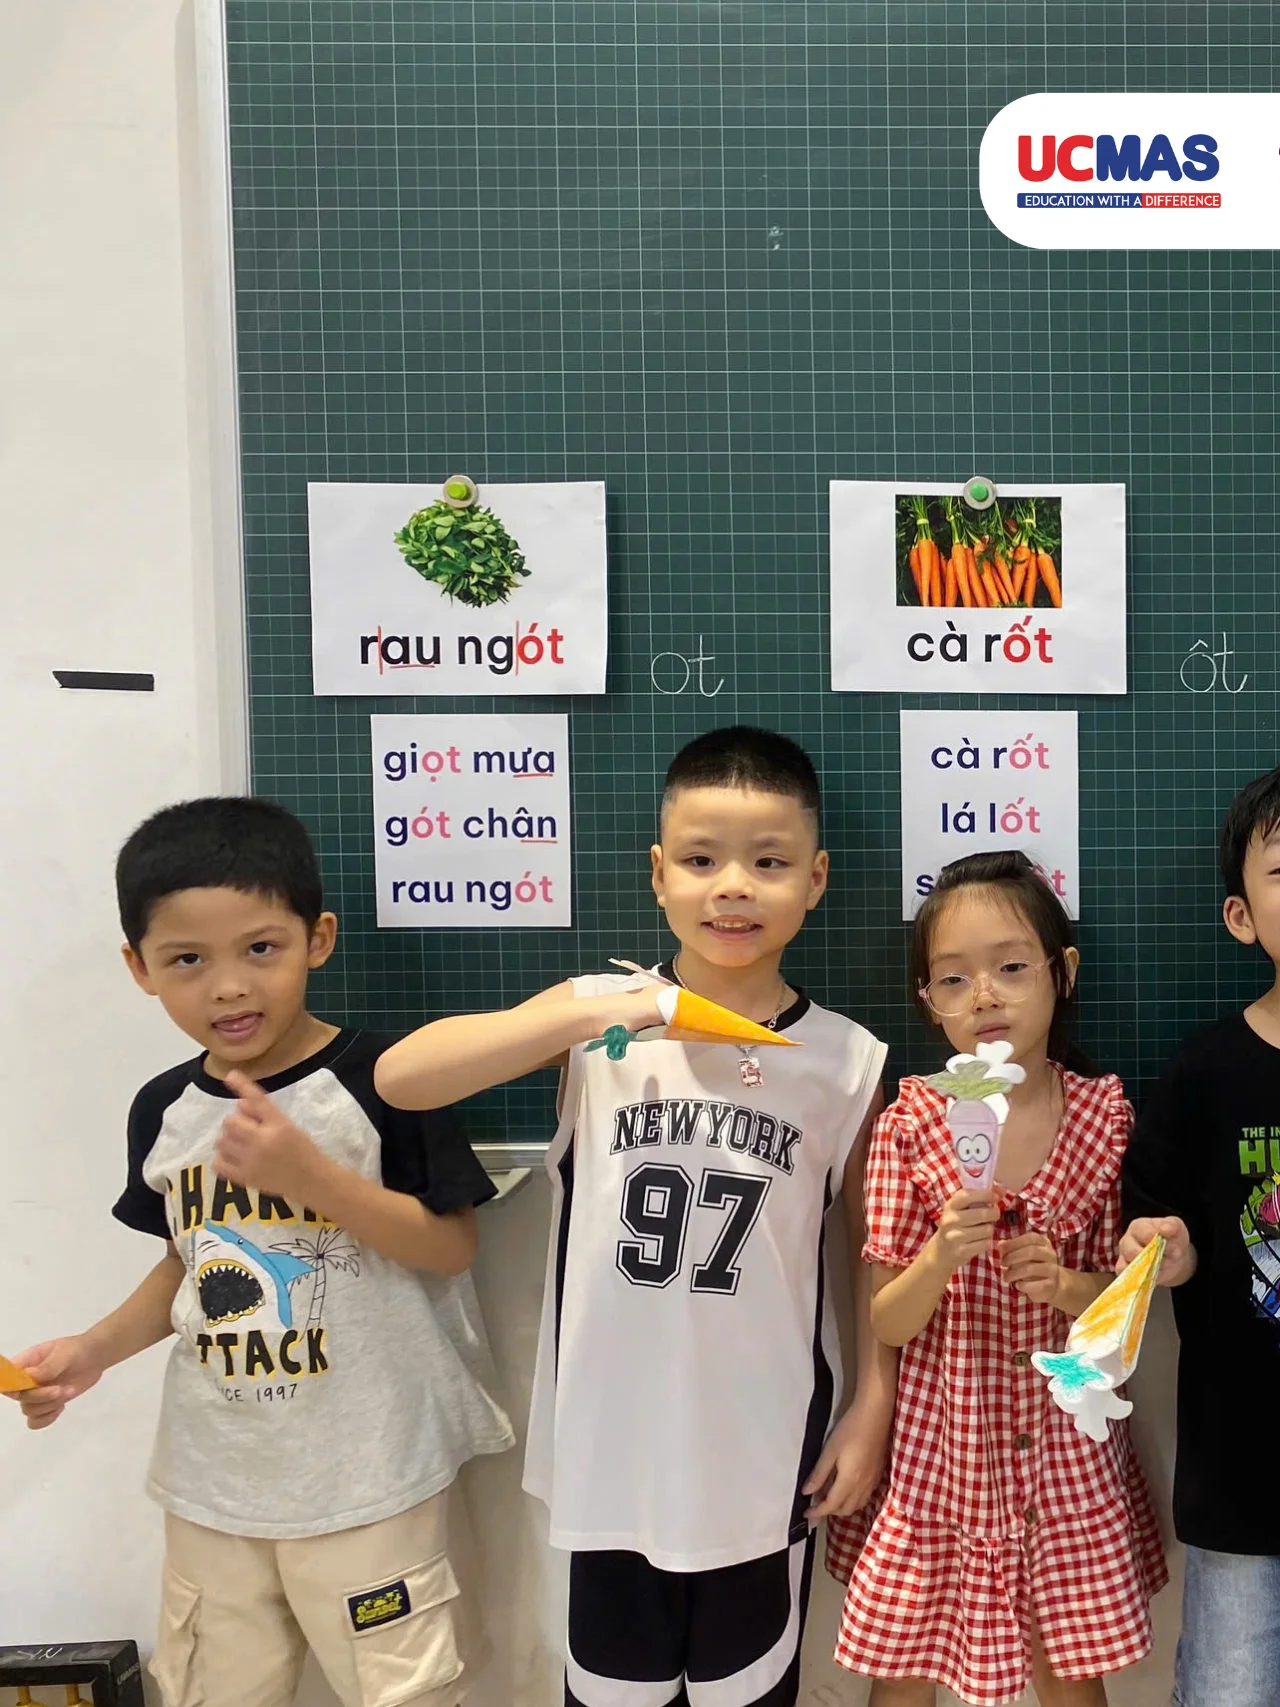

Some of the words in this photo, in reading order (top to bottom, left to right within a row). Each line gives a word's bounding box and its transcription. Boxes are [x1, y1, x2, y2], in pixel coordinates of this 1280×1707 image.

[360, 634, 441, 666] rau
[457, 623, 564, 675] ngót
[906, 620, 968, 664] cà
[984, 615, 1054, 664] rốt
[651, 634, 724, 697] ot
[1180, 631, 1248, 693] ôt
[383, 742, 461, 783] giọt
[473, 746, 556, 774] mưa
[930, 737, 981, 770] cà
[994, 733, 1050, 770] rốt
[385, 806, 452, 847] gót
[463, 807, 557, 839] chân
[941, 801, 977, 834] lá
[989, 797, 1041, 834] lốt
[392, 879, 454, 904] rau
[465, 871, 554, 911] ngót
[1242, 1126, 1266, 1138] THE
[615, 1161, 773, 1296] 97
[197, 1328, 328, 1376] TTACK
[256, 1383, 298, 1402] 1997
